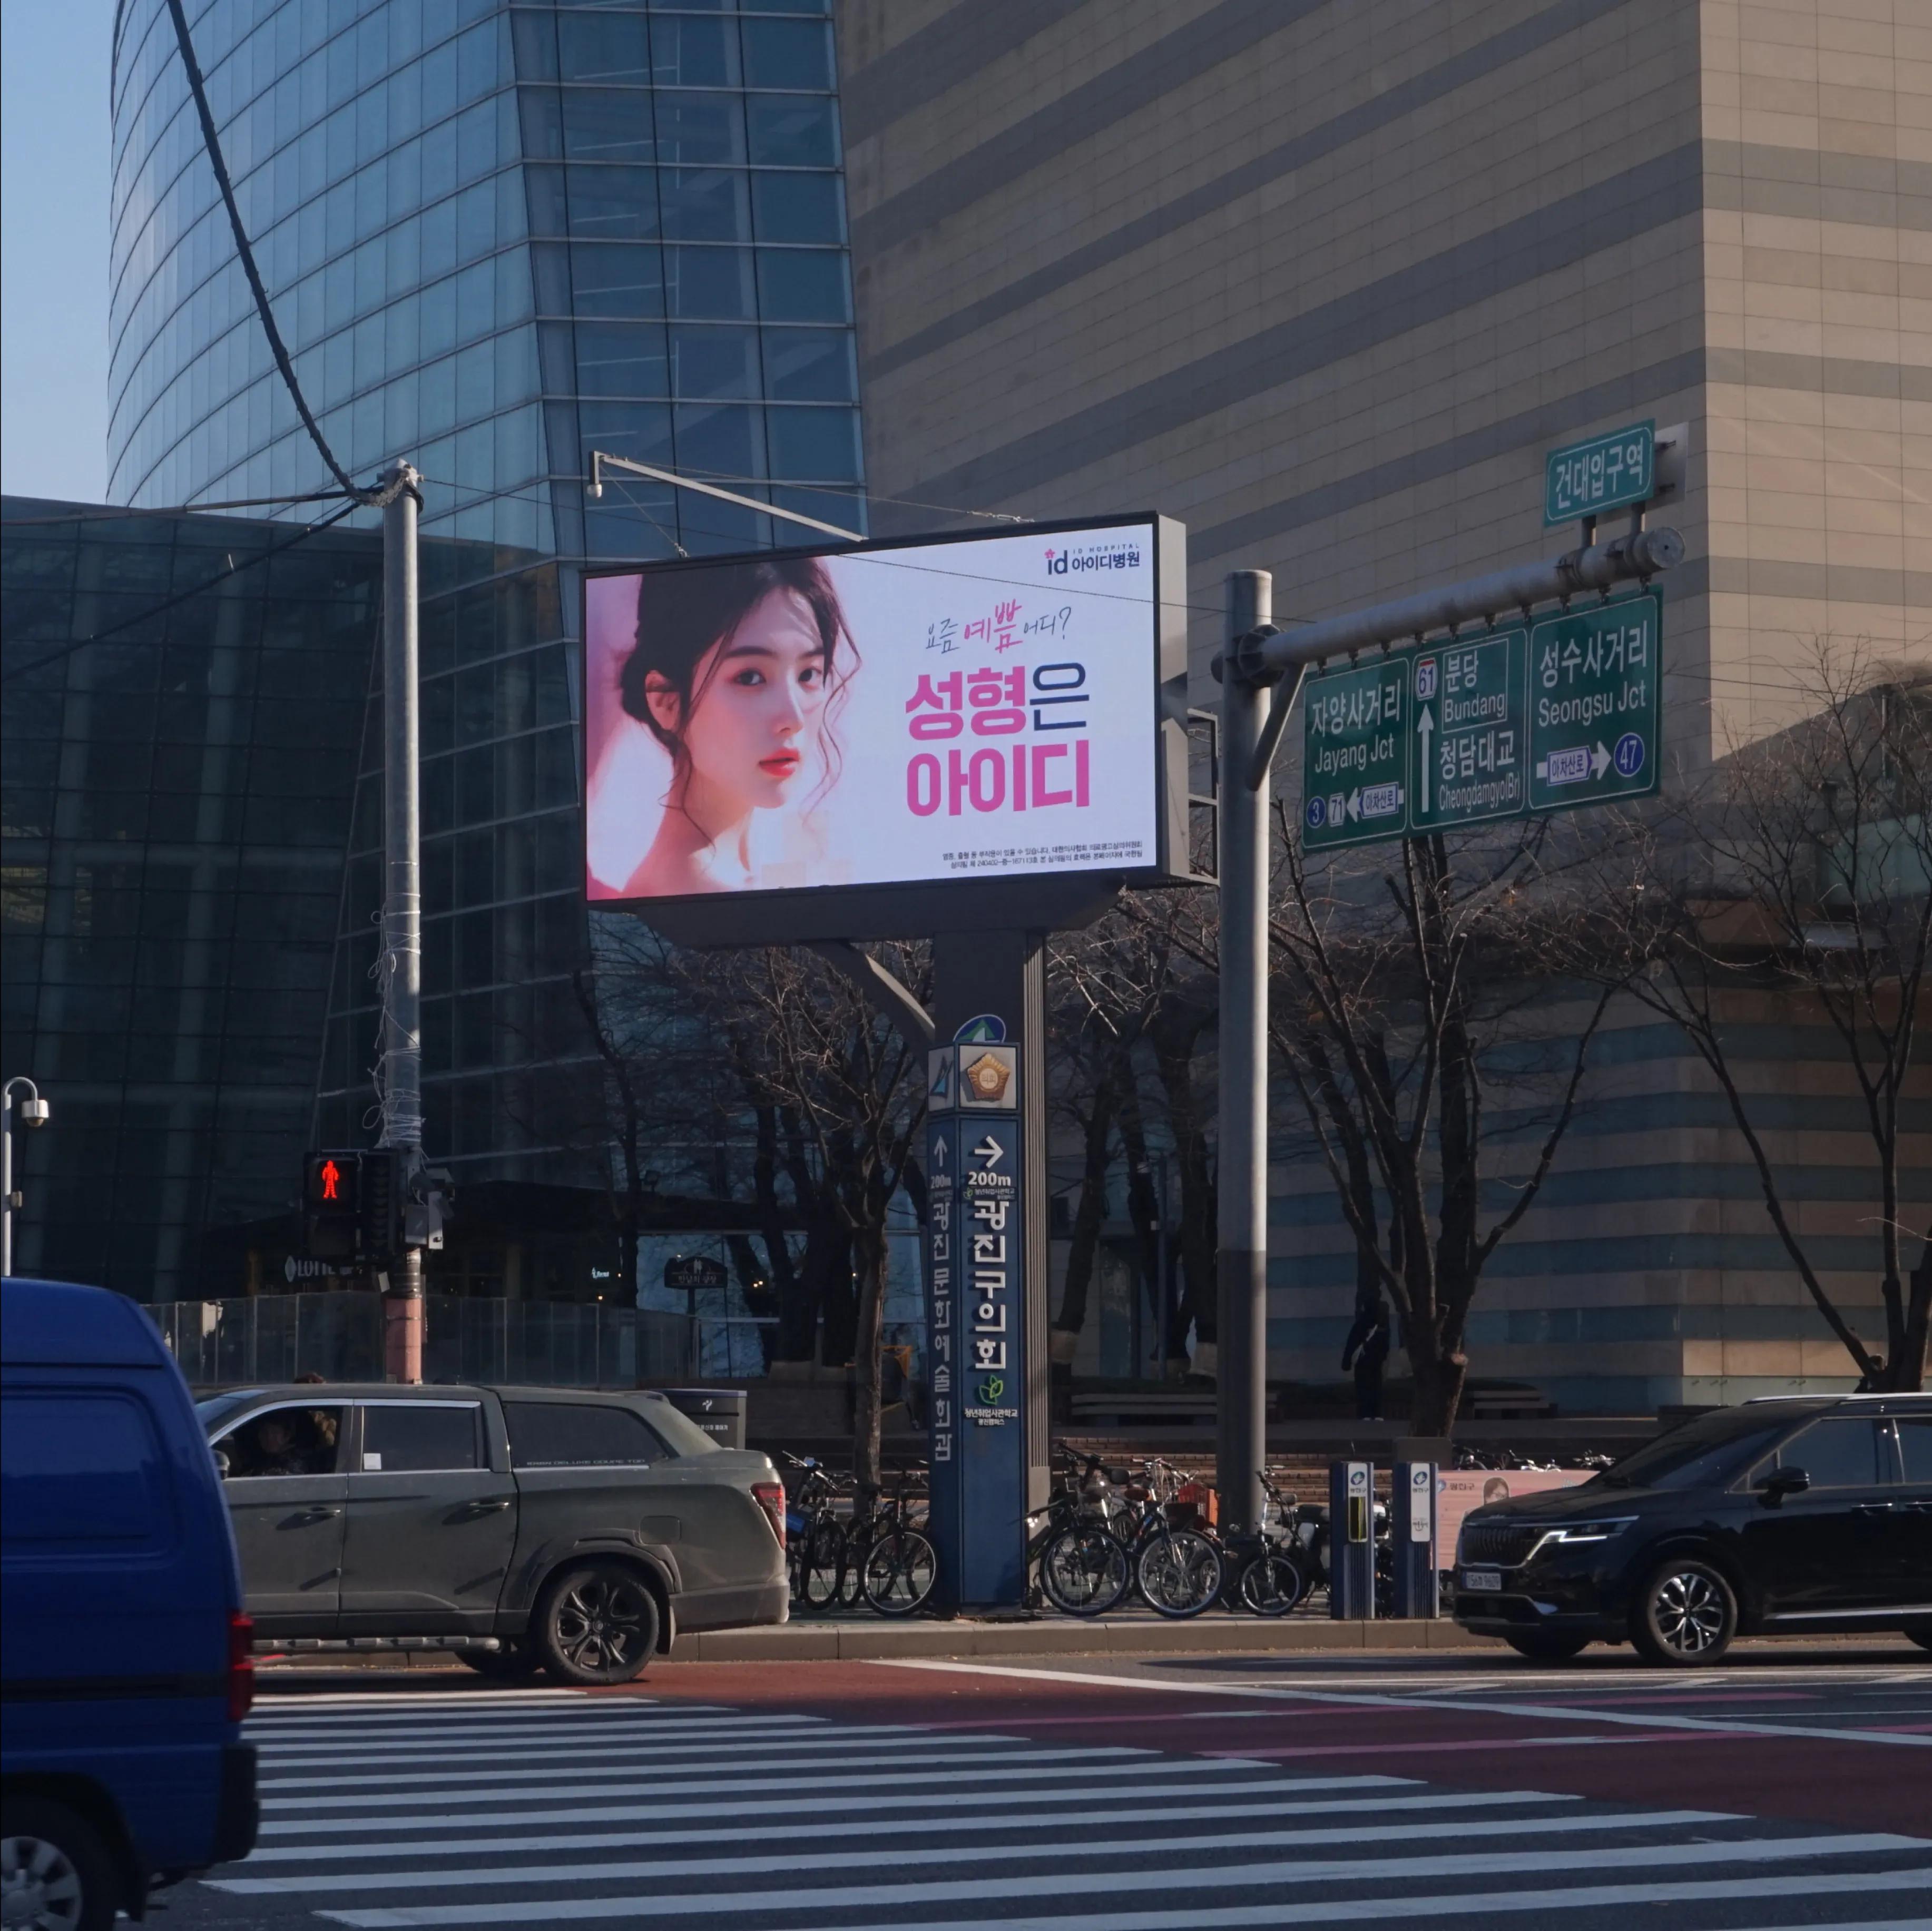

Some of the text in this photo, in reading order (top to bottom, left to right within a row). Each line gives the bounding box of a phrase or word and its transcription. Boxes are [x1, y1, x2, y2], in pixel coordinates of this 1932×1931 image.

[1556, 437, 1643, 509] 건대입구역
[1072, 551, 1140, 573] 아이디병원
[1089, 544, 1140, 553] HOSPITAL
[926, 598, 1072, 654] 요즘 예쁨 어디?
[1445, 649, 1479, 693] 분당
[1539, 619, 1648, 688] 성수사거리
[905, 662, 1090, 741] 성형은
[1418, 667, 1435, 695] 61
[1311, 678, 1401, 738] 자양사거리
[1445, 693, 1505, 723] Bundang
[1538, 679, 1646, 727] Seongsu Jct
[1315, 733, 1394, 777] Jayang Jct
[1440, 730, 1515, 780] 청담대교
[1551, 753, 1585, 779] 아차산로
[1620, 740, 1637, 770] 47
[907, 740, 1090, 816] 아이디
[1439, 771, 1520, 812] Cheongdamgyo(Br)
[1311, 802, 1320, 823] 3
[1331, 797, 1343, 823] 71
[1366, 787, 1396, 812] 아차산로
[968, 1171, 1011, 1186] 200m
[974, 1200, 1009, 1370] 광진구의회
[933, 1201, 953, 1461] 광진문화예술회관
[965, 1408, 1018, 1418] 청년취업사관학교
